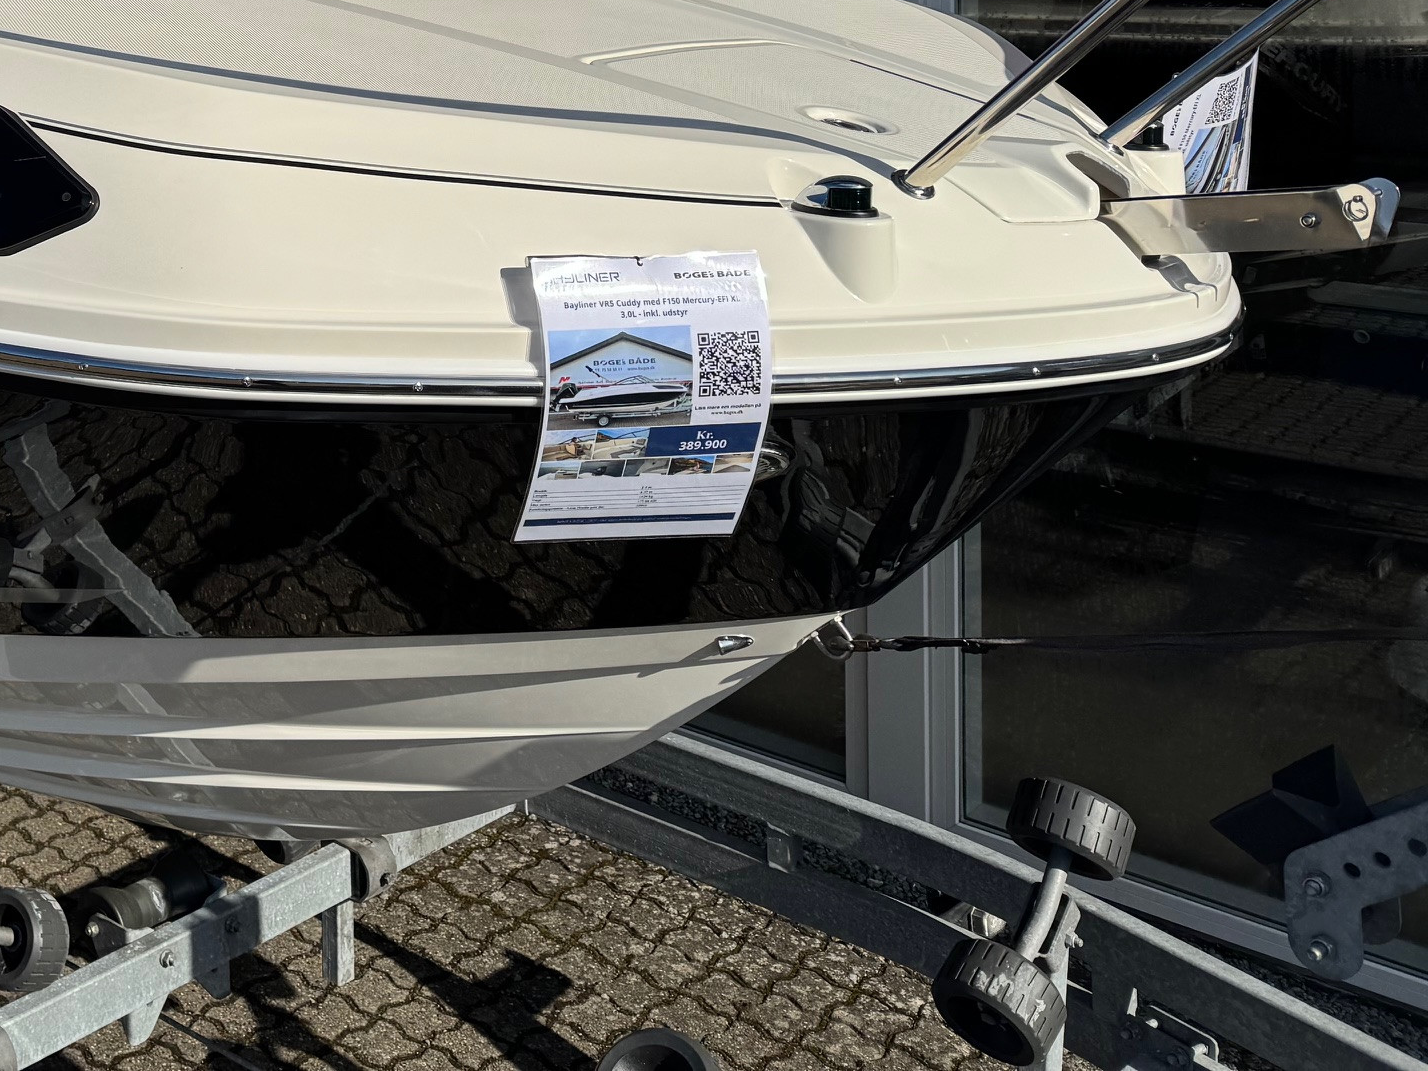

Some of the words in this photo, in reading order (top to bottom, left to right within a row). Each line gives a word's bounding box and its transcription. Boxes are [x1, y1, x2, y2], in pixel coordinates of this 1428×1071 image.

[564, 301, 597, 311] Bayliner
[616, 299, 641, 309] Cuddy
[643, 298, 661, 306] med
[662, 297, 681, 305] F150
[662, 308, 688, 317] udstyr
[696, 430, 714, 440] Kr.
[678, 439, 727, 451] 389.900
